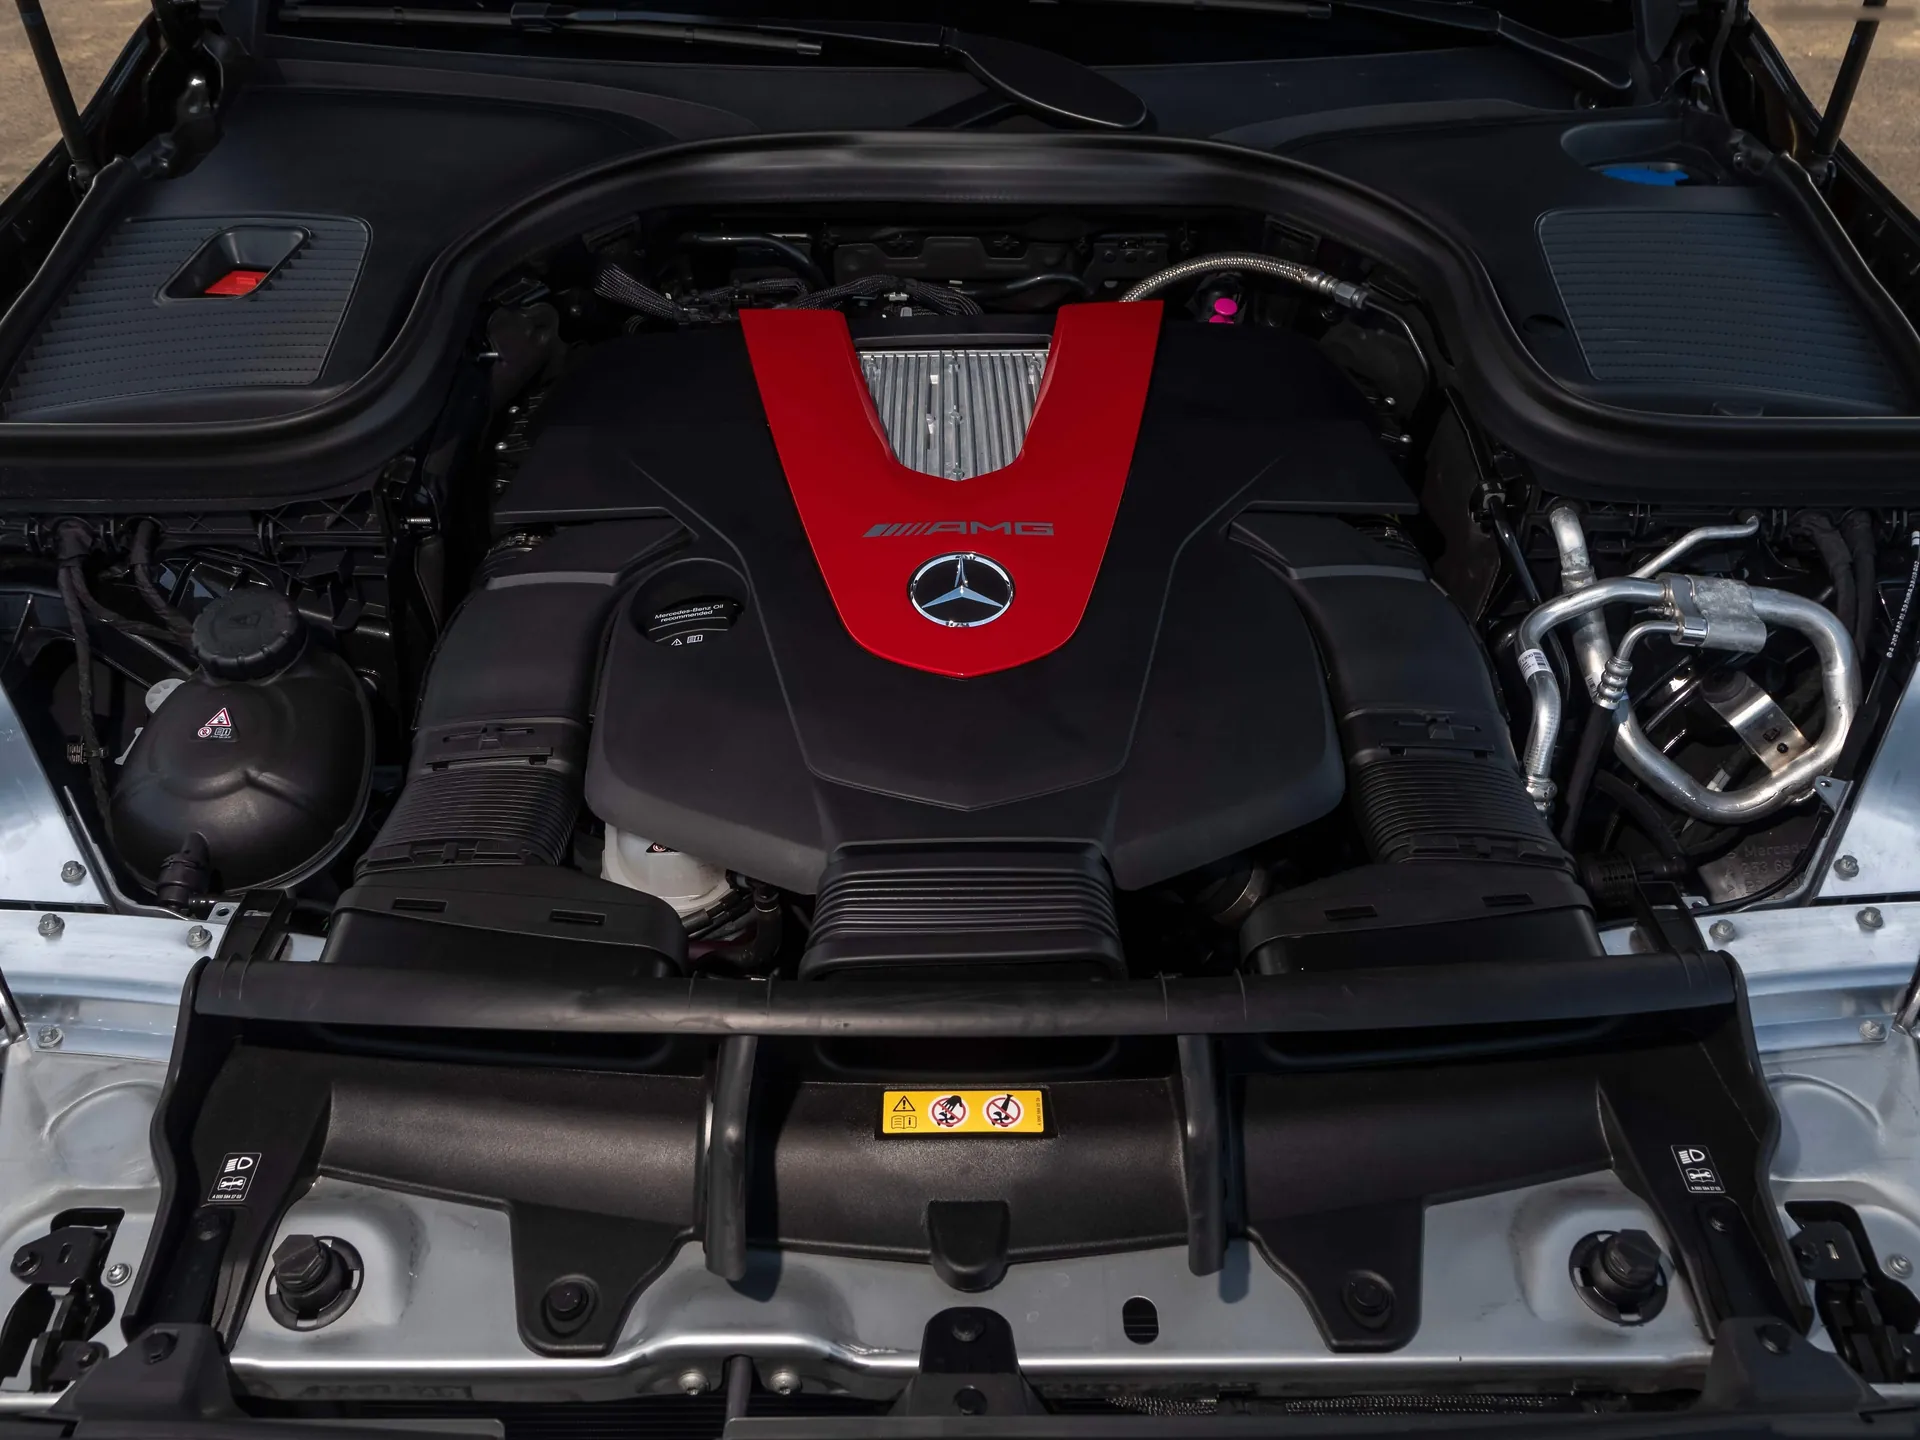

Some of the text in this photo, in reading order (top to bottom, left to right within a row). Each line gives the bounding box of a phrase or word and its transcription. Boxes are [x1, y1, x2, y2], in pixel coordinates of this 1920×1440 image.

[923, 521, 1055, 536] AMG
[654, 606, 711, 619] Mercedes-Benz
[660, 610, 713, 622] recommended
[1744, 842, 1808, 858] Mercede
